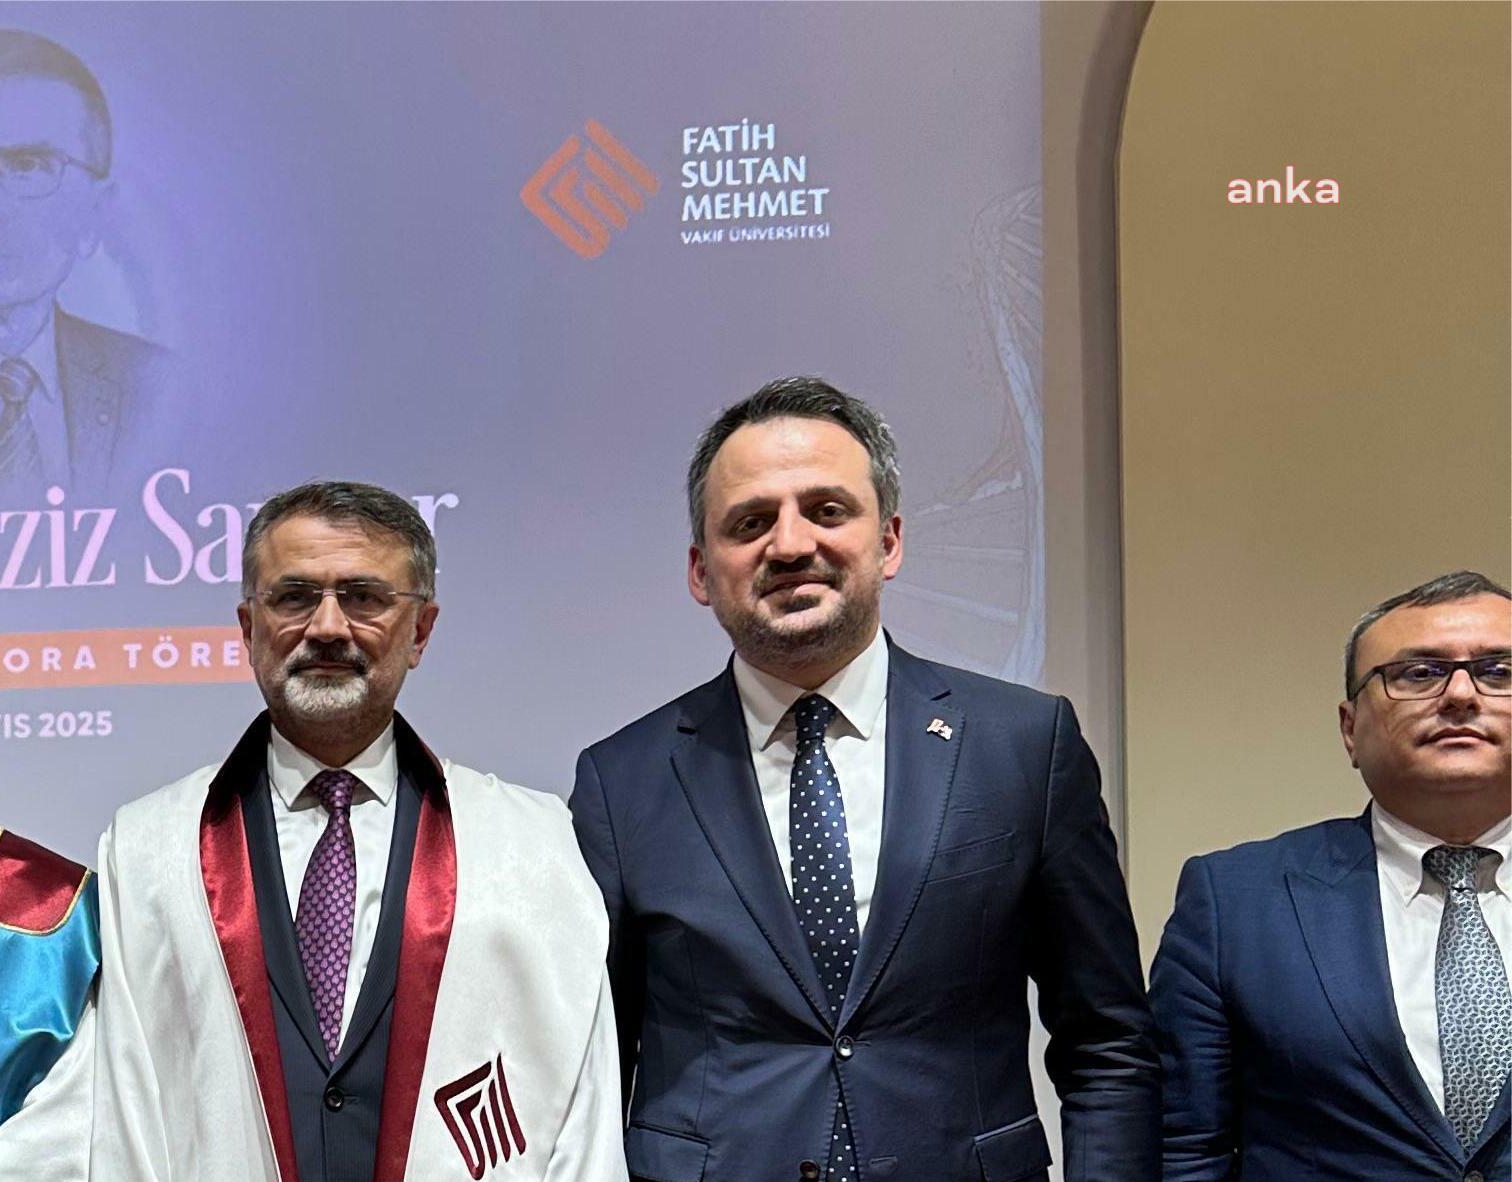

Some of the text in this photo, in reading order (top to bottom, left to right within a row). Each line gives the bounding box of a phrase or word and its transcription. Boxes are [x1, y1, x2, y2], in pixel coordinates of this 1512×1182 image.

[682, 118, 775, 154] FATİH
[681, 155, 806, 188] SULTAN
[681, 188, 830, 222] MEHMET
[681, 229, 723, 244] VAKIF
[123, 635, 241, 669] TÖRE
[38, 711, 113, 738] 2025
